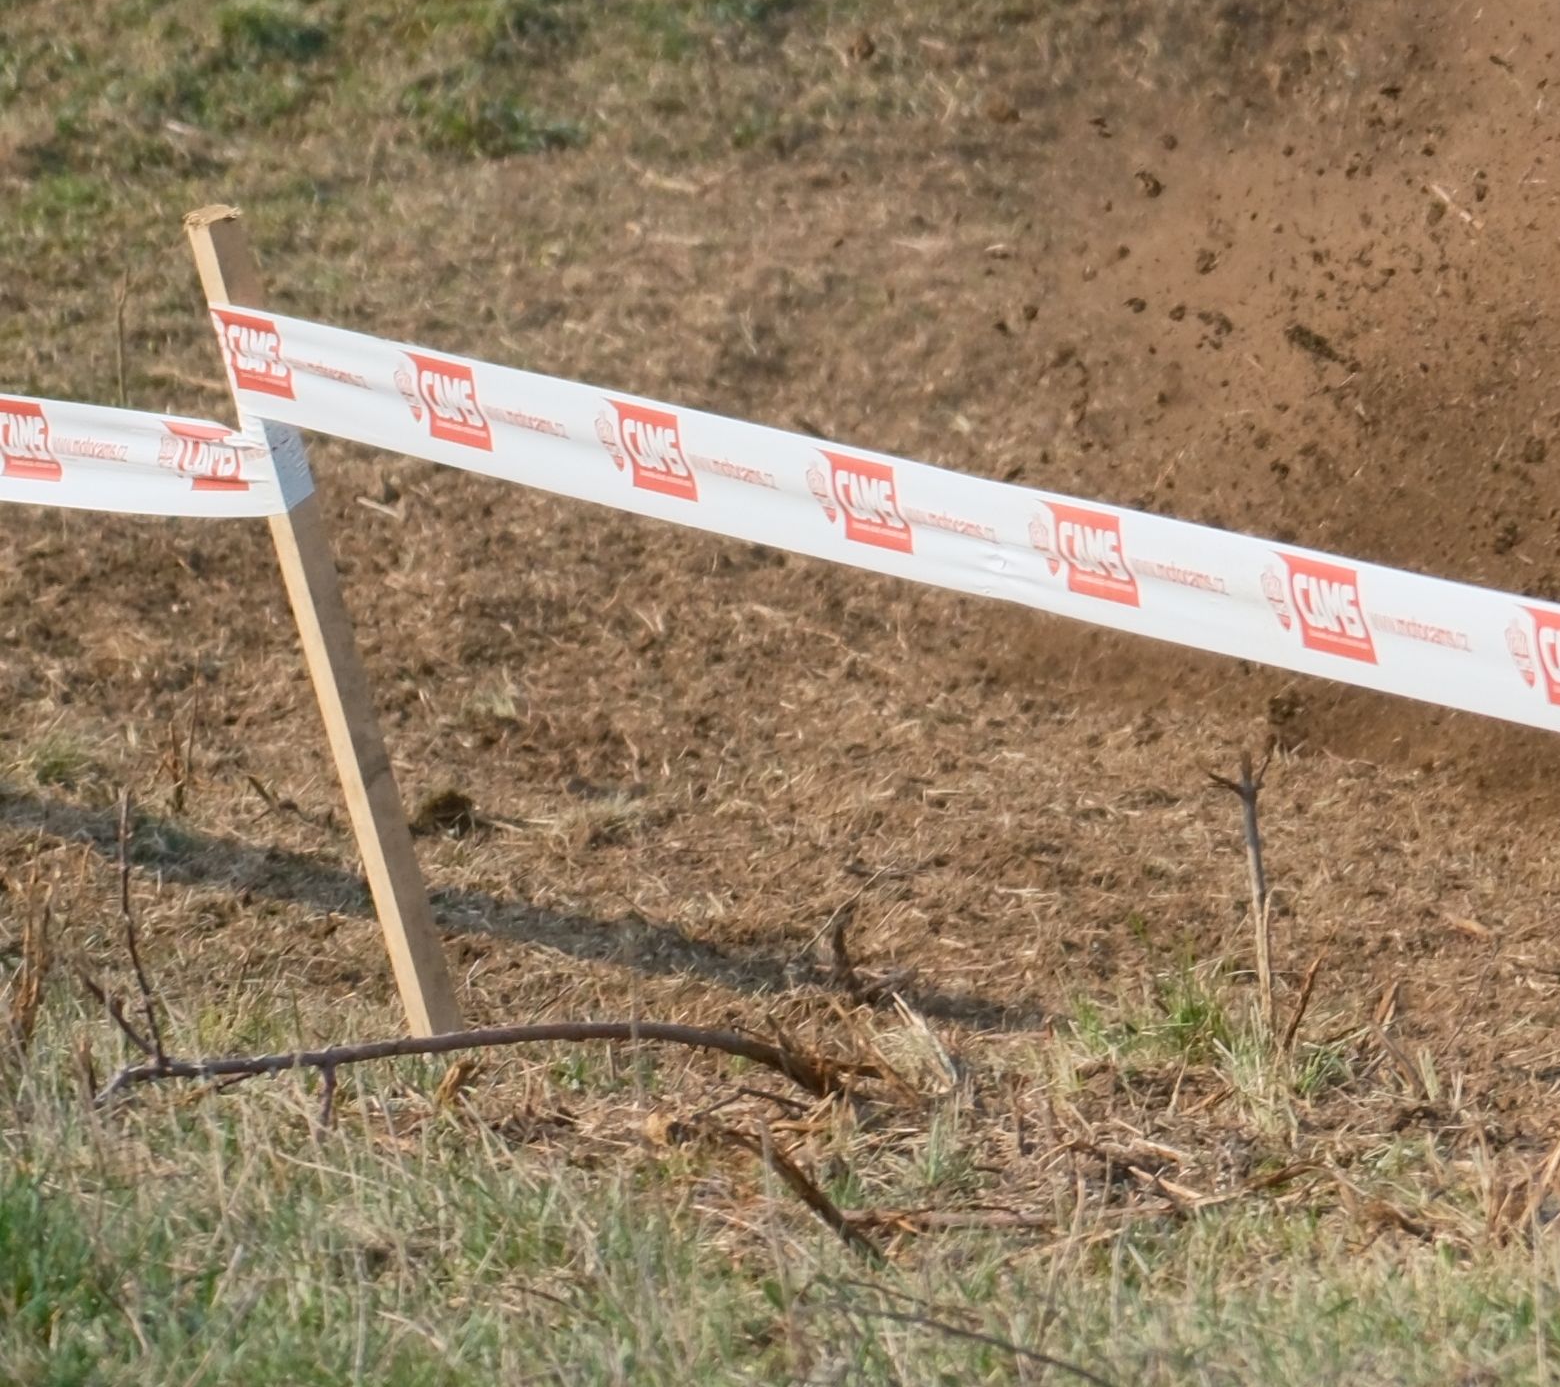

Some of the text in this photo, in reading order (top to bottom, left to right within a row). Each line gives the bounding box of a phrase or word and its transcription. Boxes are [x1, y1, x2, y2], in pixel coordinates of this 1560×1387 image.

[420, 369, 485, 428] CAMS
[621, 417, 690, 477] CAMS
[834, 469, 906, 529] CAMS
[1058, 520, 1133, 582] CAMS
[1292, 572, 1368, 640] CAMS
